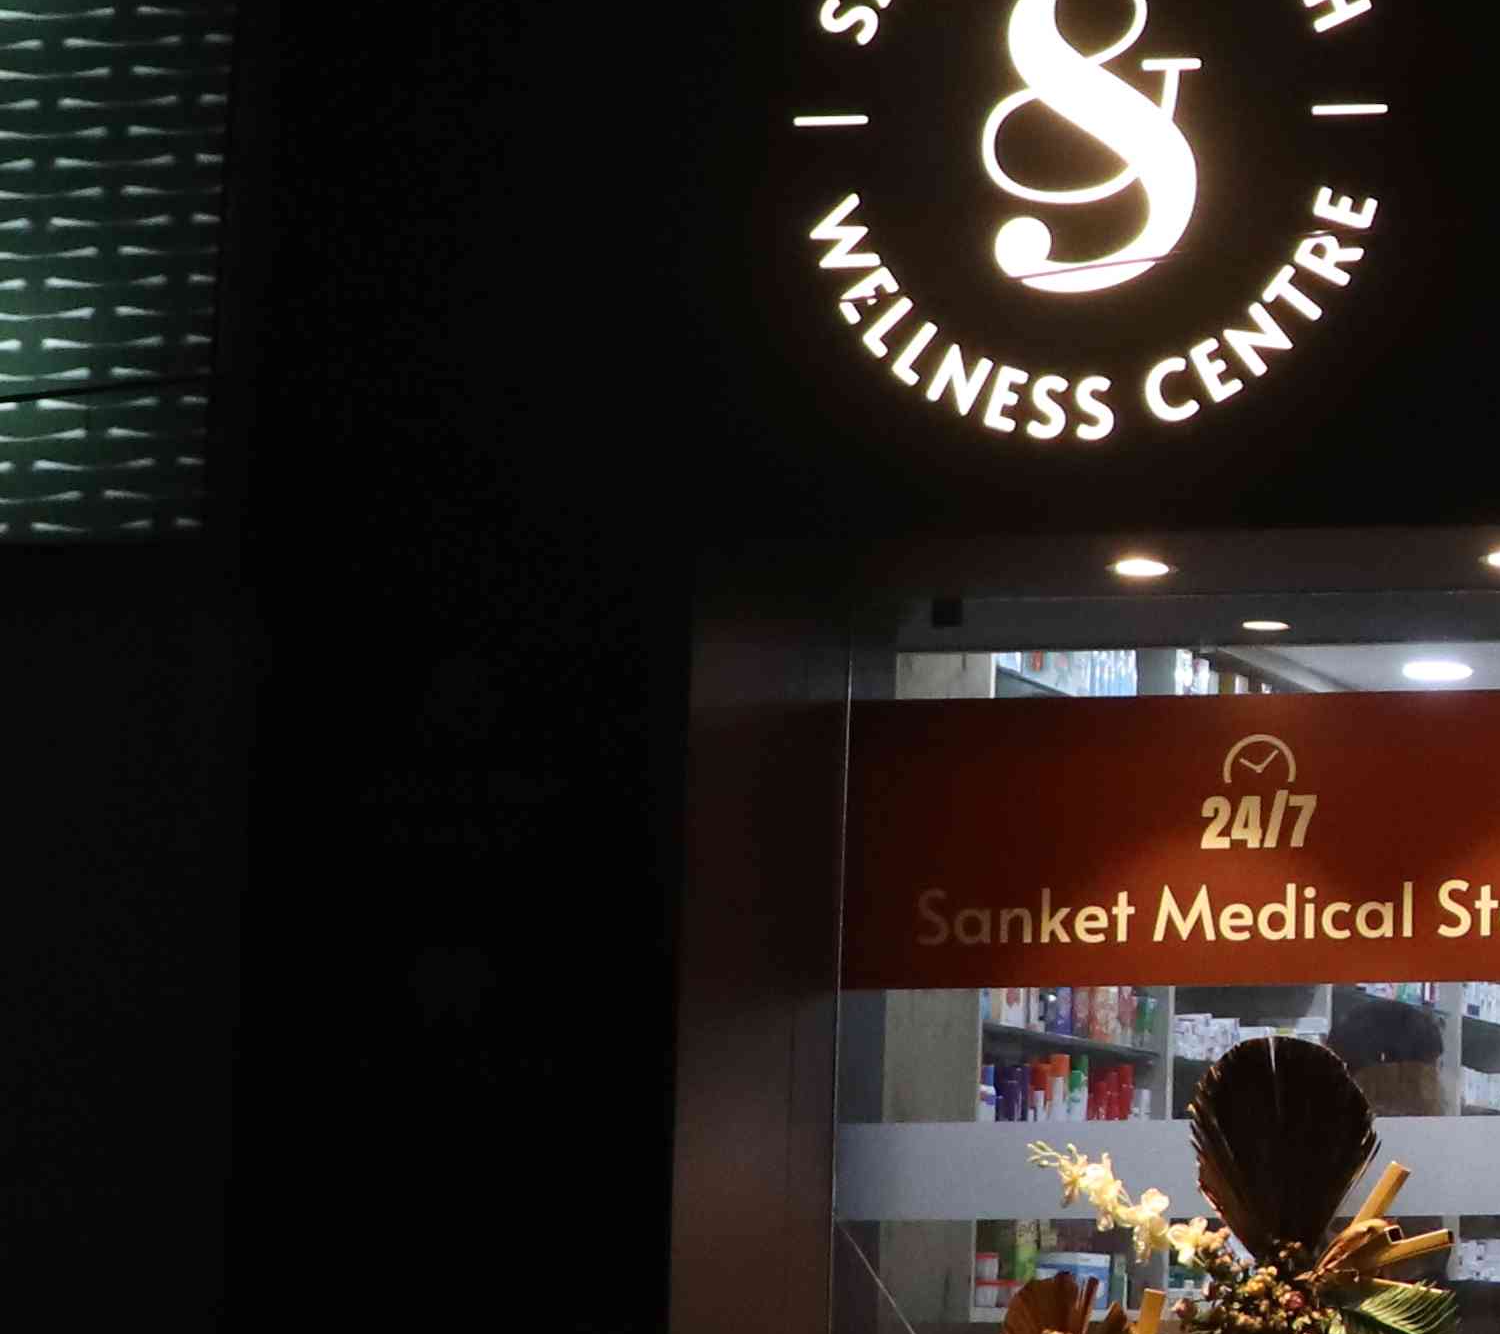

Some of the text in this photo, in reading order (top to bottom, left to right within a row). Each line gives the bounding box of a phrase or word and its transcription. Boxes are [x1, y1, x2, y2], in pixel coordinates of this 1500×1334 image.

[808, 185, 1379, 442] WELLNESS CENTRE
[1200, 789, 1318, 850] 24/7
[916, 888, 1137, 947] Sanket
[1151, 880, 1414, 945] Medical
